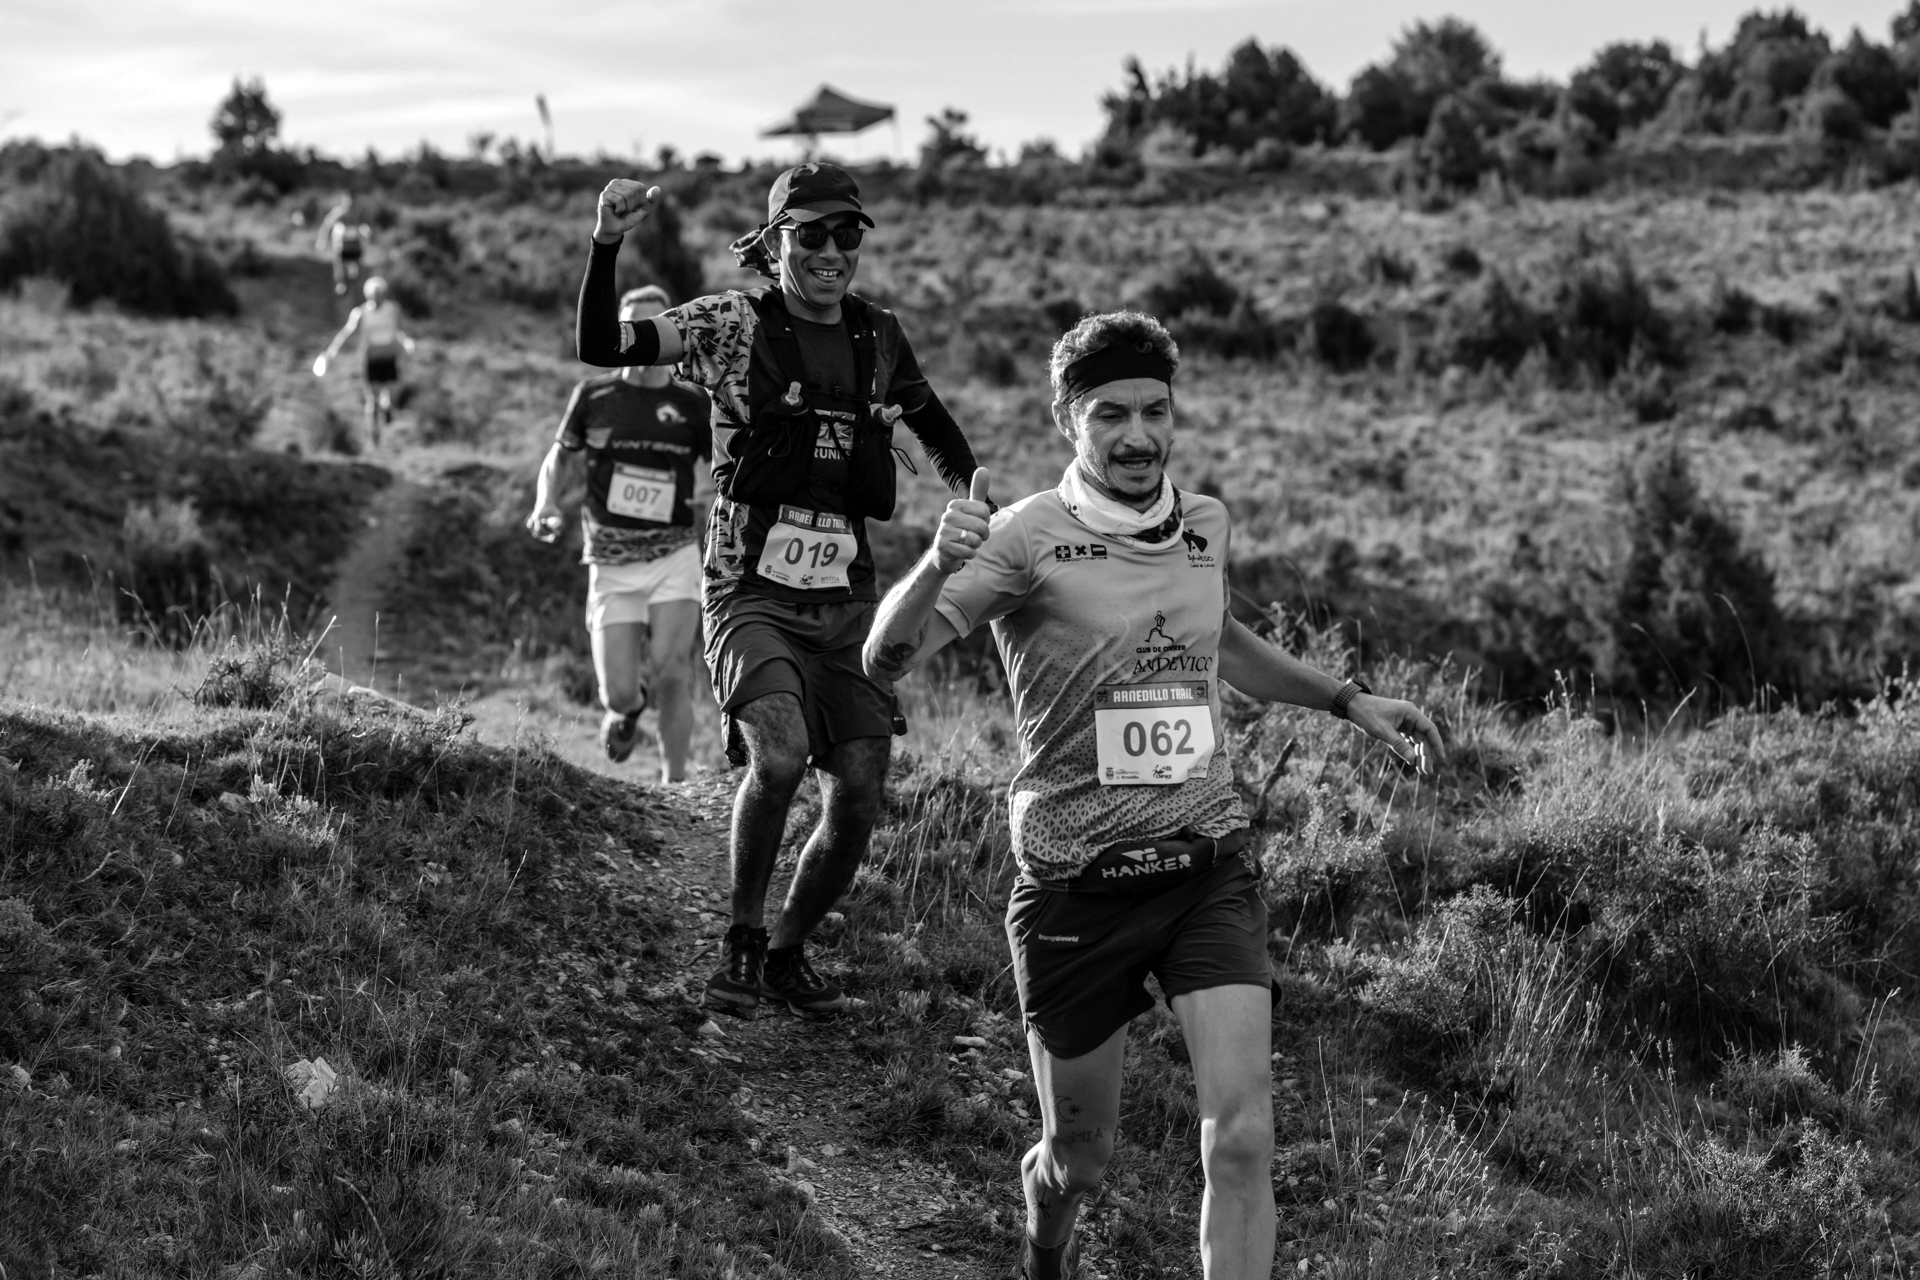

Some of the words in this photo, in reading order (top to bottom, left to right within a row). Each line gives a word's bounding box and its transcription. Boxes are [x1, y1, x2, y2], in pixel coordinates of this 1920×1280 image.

[623, 484, 662, 505] 007
[784, 537, 840, 569] 019
[1113, 688, 1169, 702] ARNEDILLO
[1170, 687, 1194, 700] TRAIL
[1123, 718, 1195, 757] 062
[1101, 853, 1191, 878] HANKER
